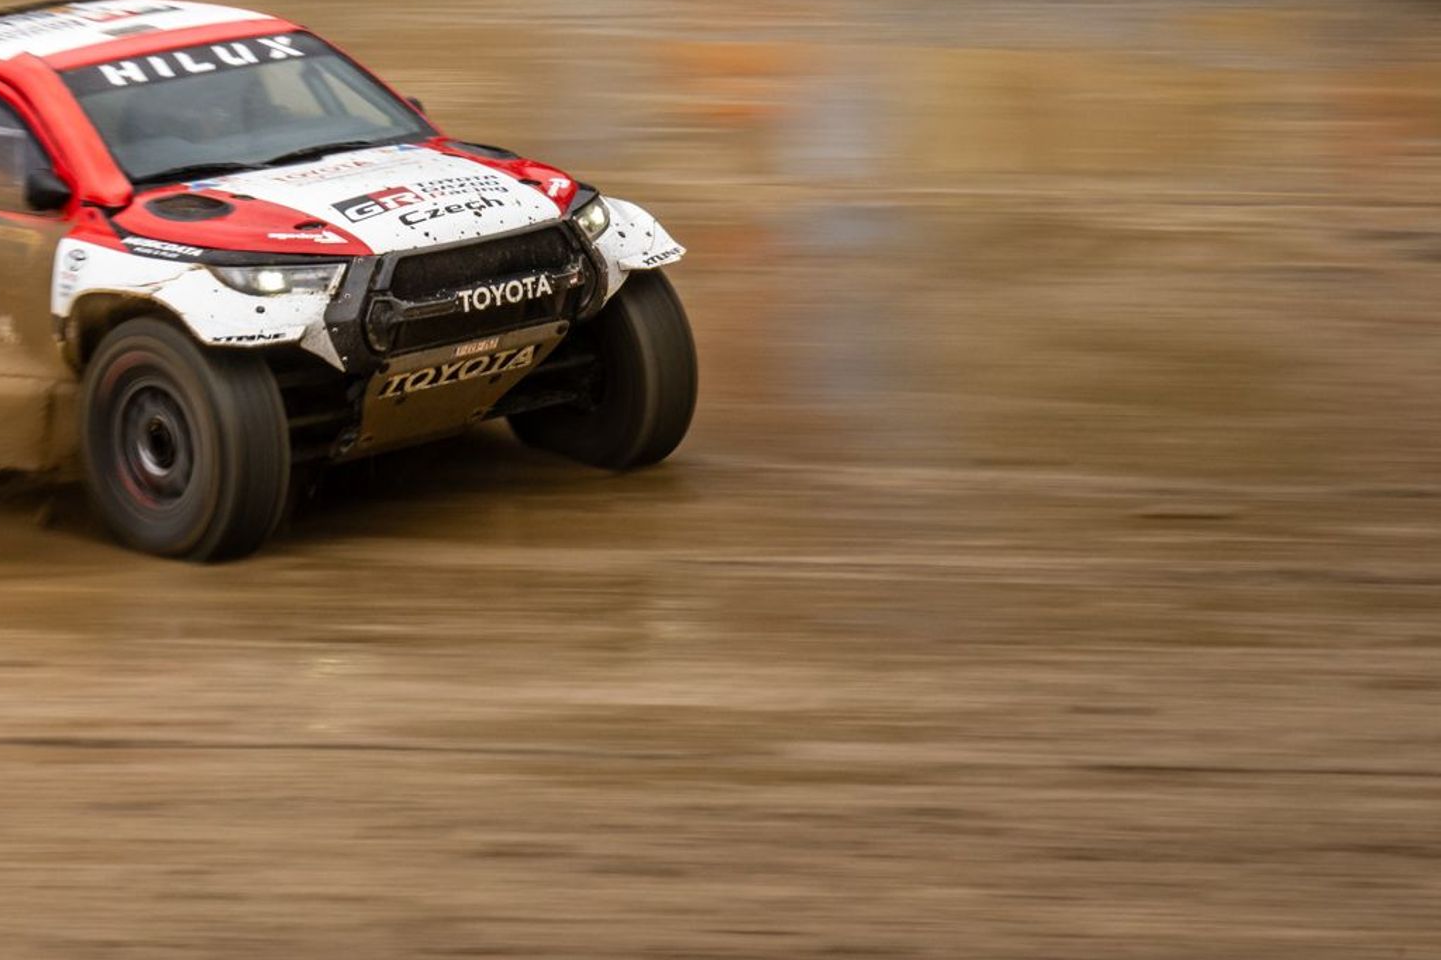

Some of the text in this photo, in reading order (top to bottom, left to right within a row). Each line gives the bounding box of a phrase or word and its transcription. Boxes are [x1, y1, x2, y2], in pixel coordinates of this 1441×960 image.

[97, 36, 306, 87] HILUX
[416, 173, 498, 188] TOYOTA
[428, 186, 509, 199] Racing
[343, 190, 424, 221] GR
[398, 194, 505, 226] Czech
[459, 274, 553, 313] TOYOTA
[378, 344, 539, 399] TOYOTA
